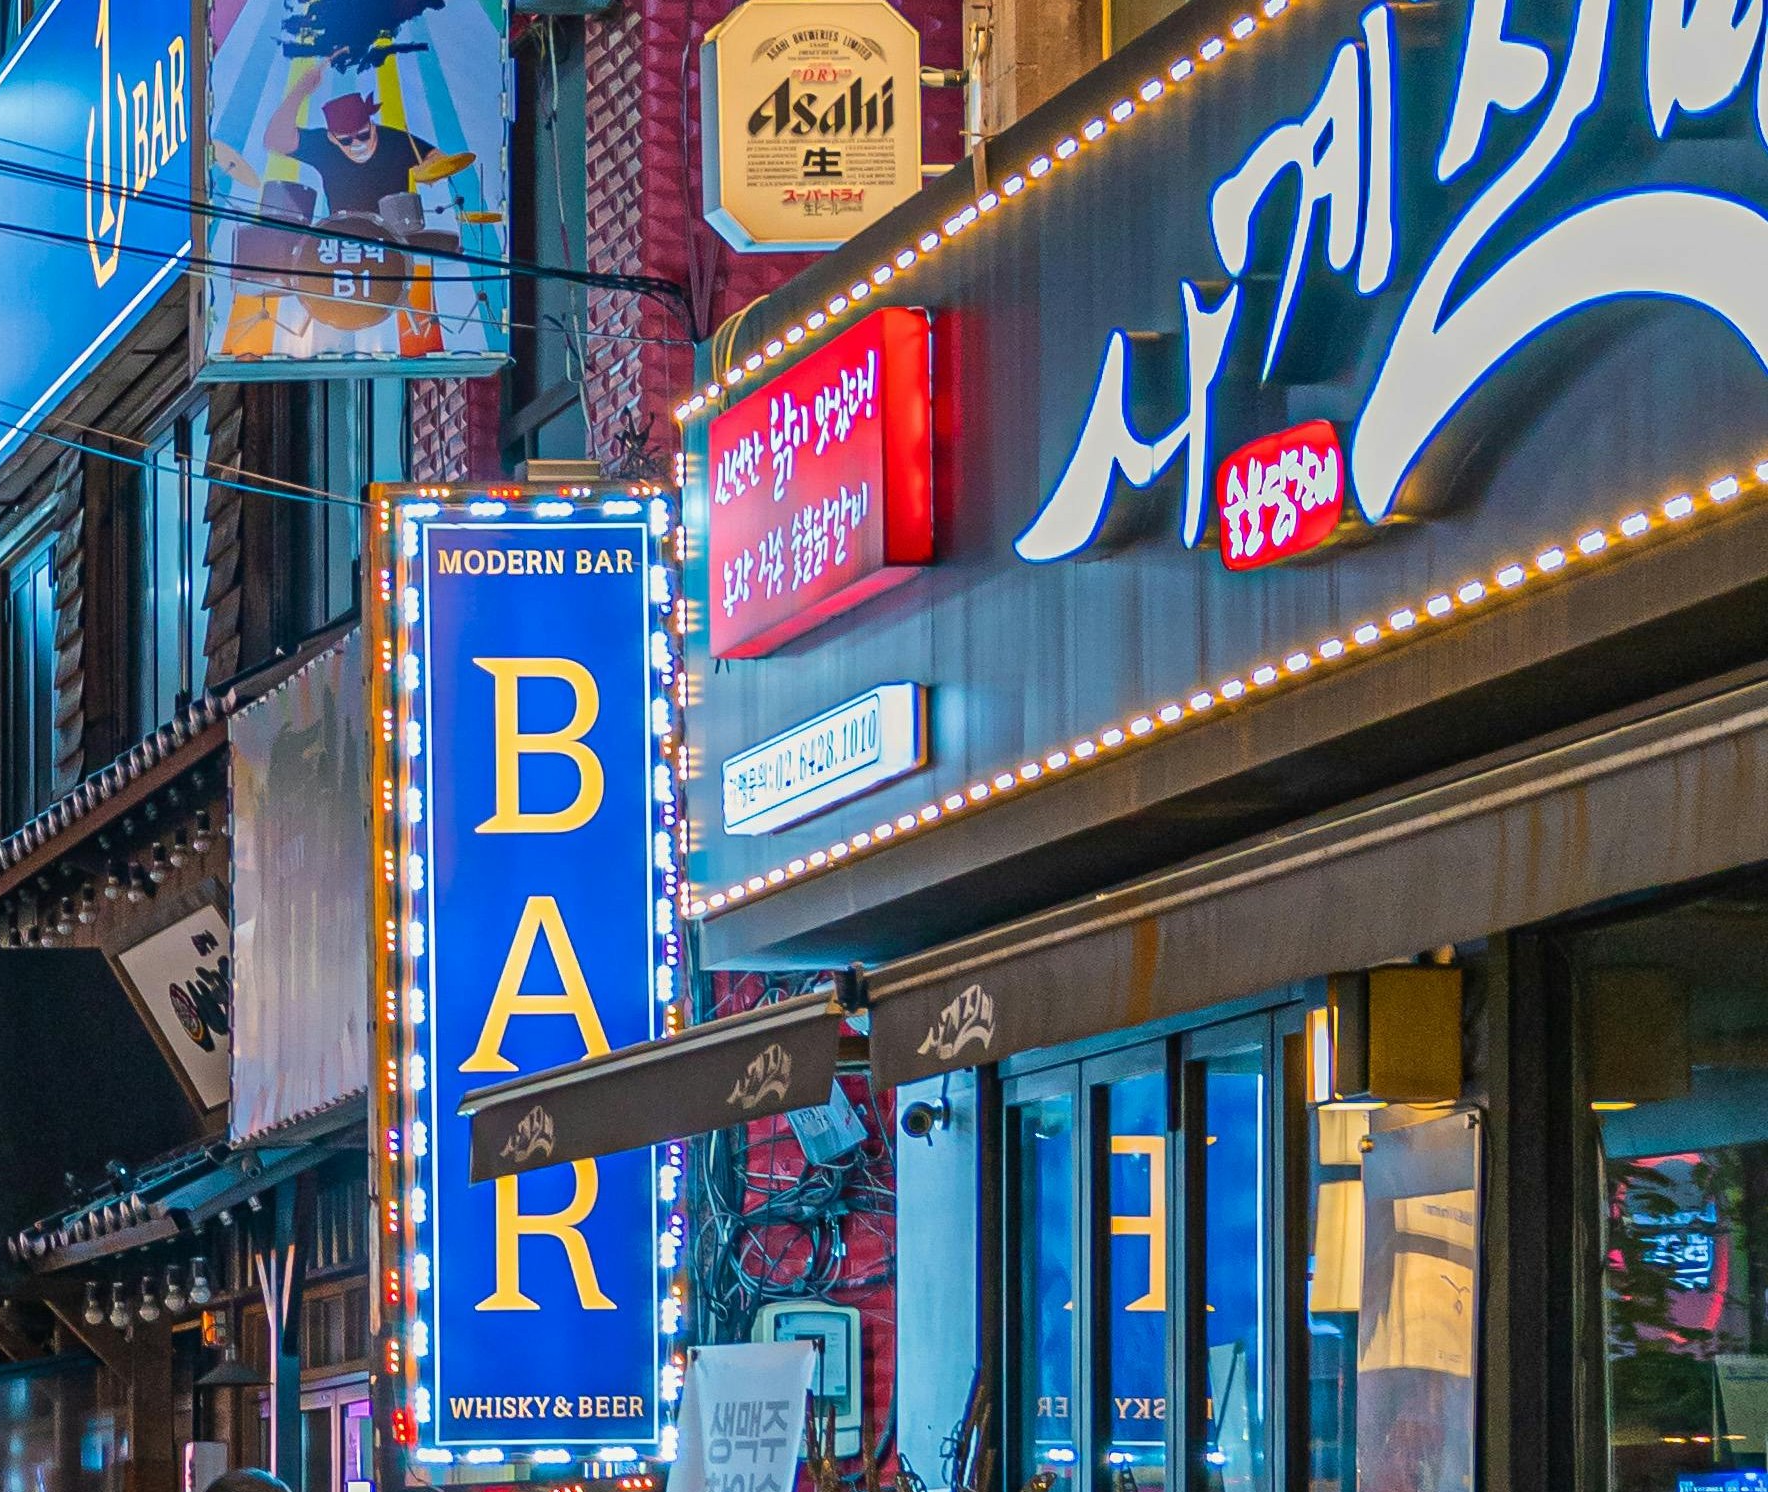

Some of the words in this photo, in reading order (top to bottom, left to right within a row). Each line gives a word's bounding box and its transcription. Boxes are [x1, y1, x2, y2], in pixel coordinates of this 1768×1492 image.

[748, 76, 894, 137] Asahi
[802, 147, 843, 178] 生
[783, 188, 865, 203] スーパードライ
[331, 268, 373, 300] B1
[715, 428, 764, 507] 신선한
[437, 549, 565, 576] MODERN
[573, 549, 635, 576] BAR
[457, 656, 618, 1313] BAR
[708, 1399, 790, 1468] 생맥주
